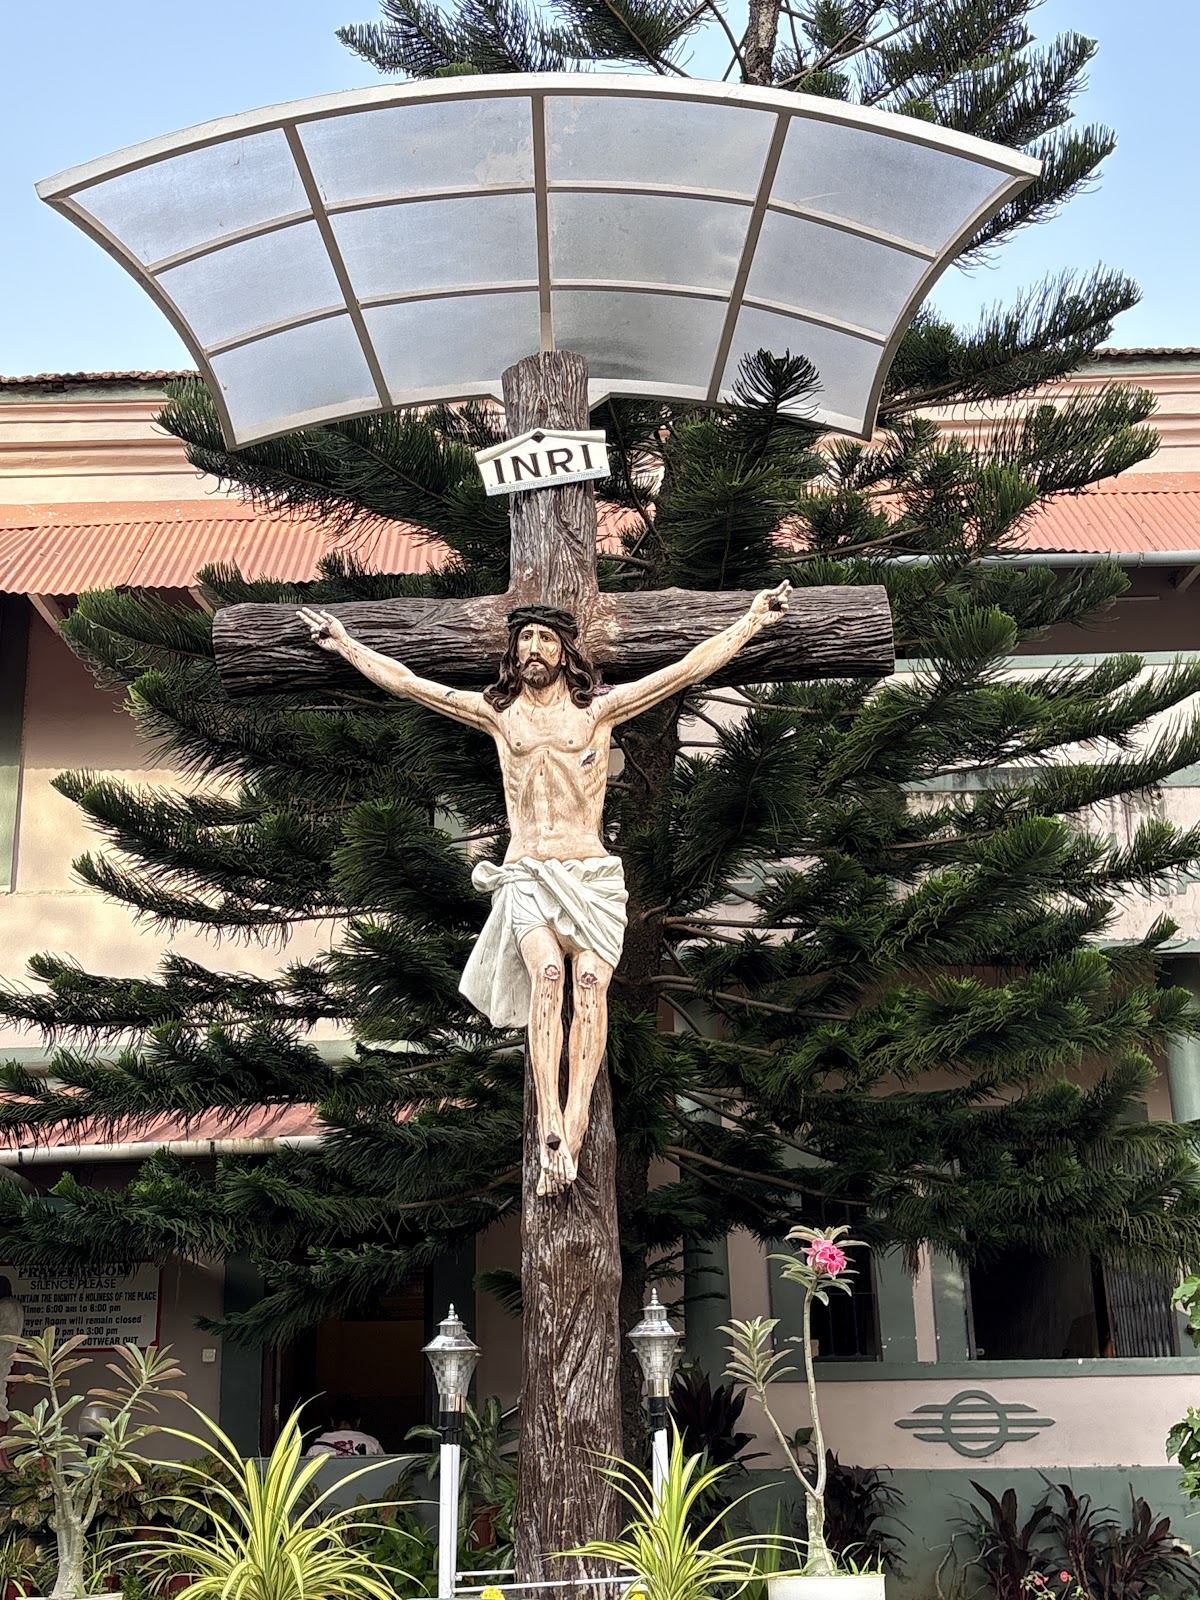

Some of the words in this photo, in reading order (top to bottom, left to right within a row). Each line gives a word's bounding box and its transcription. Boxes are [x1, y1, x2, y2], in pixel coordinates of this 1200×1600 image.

[30, 1279, 75, 1290] SILENCE
[78, 1279, 116, 1289] PLEASE
[41, 1294, 52, 1303] THE
[53, 1293, 77, 1302] DIGNITY
[78, 1293, 84, 1302] &
[85, 1292, 114, 1302] HOLINESS
[114, 1292, 123, 1301] OF
[124, 1291, 137, 1301] THE
[137, 1291, 157, 1301] PLACE
[22, 1305, 43, 1314] Time:
[79, 1304, 88, 1313] to
[109, 1304, 121, 1314] pm
[44, 1317, 67, 1325] Room
[69, 1316, 83, 1325] will
[85, 1315, 113, 1325] remain
[114, 1314, 142, 1324] closed
[62, 1328, 74, 1337] pm
[76, 1327, 85, 1335] to
[86, 1326, 104, 1335] 3:00
[105, 1327, 118, 1337] pm
